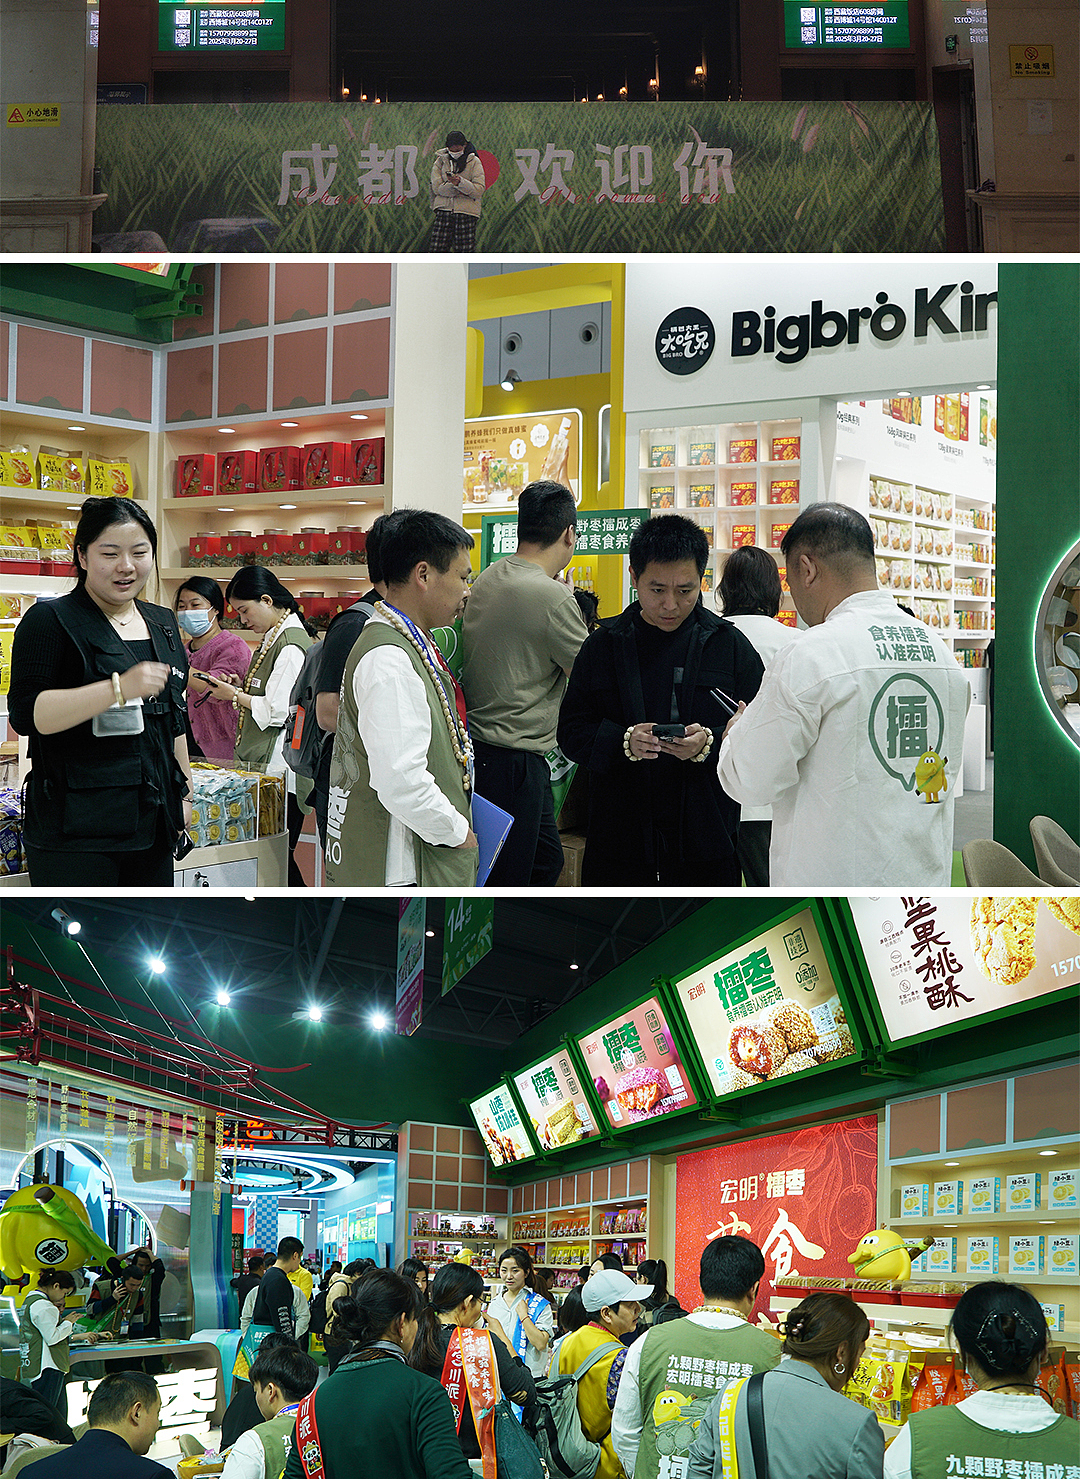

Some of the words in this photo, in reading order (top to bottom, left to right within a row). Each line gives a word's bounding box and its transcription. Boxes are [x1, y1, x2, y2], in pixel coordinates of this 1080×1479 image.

[1015, 62, 1051, 71] 禁止吸烟
[26, 107, 59, 118] 小心地滑
[277, 142, 420, 206] 成都
[514, 142, 736, 206] 欢迎你
[294, 186, 409, 210] Chengdu
[540, 183, 669, 207] Welcomes
[680, 190, 725, 209] you
[868, 624, 930, 646] 食养擂枣
[875, 642, 936, 664] 认准宏明
[886, 694, 928, 759] 擂
[713, 946, 778, 1010] 擂枣
[719, 1174, 759, 1205] 宏明
[766, 1168, 806, 1198] 擂枣
[667, 1353, 754, 1379] 九颗野枣擂成枣
